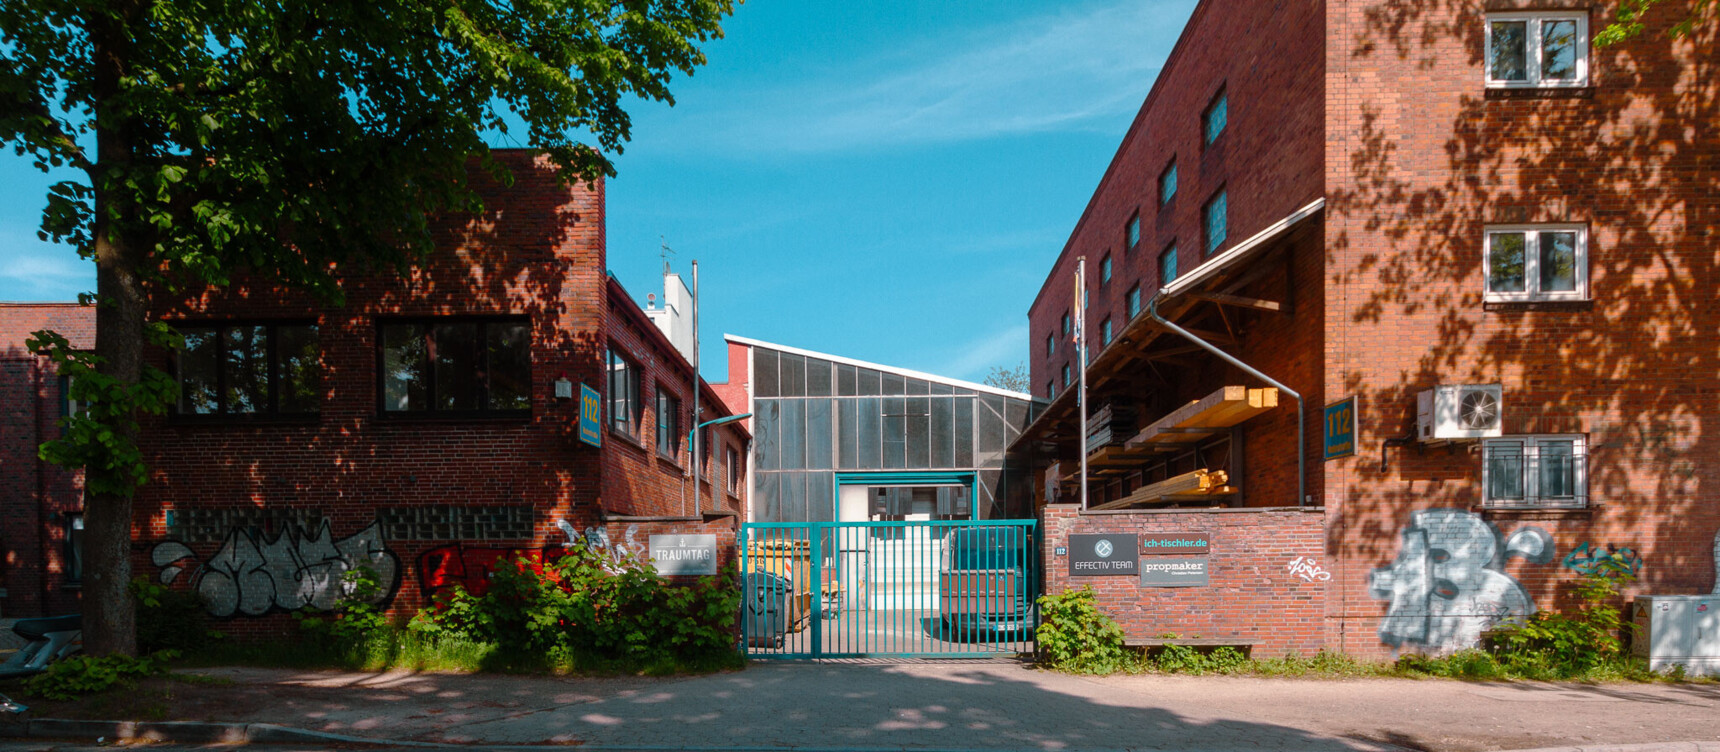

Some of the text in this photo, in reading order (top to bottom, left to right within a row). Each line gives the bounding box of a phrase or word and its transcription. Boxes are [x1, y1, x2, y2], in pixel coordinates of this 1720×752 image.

[584, 395, 598, 424] 112
[1328, 408, 1351, 437] 112
[1144, 538, 1207, 548] ich-tischler.de
[656, 549, 710, 560] TRAUMTAG
[1111, 561, 1133, 569] TEAM
[1146, 561, 1204, 573] propmaker
